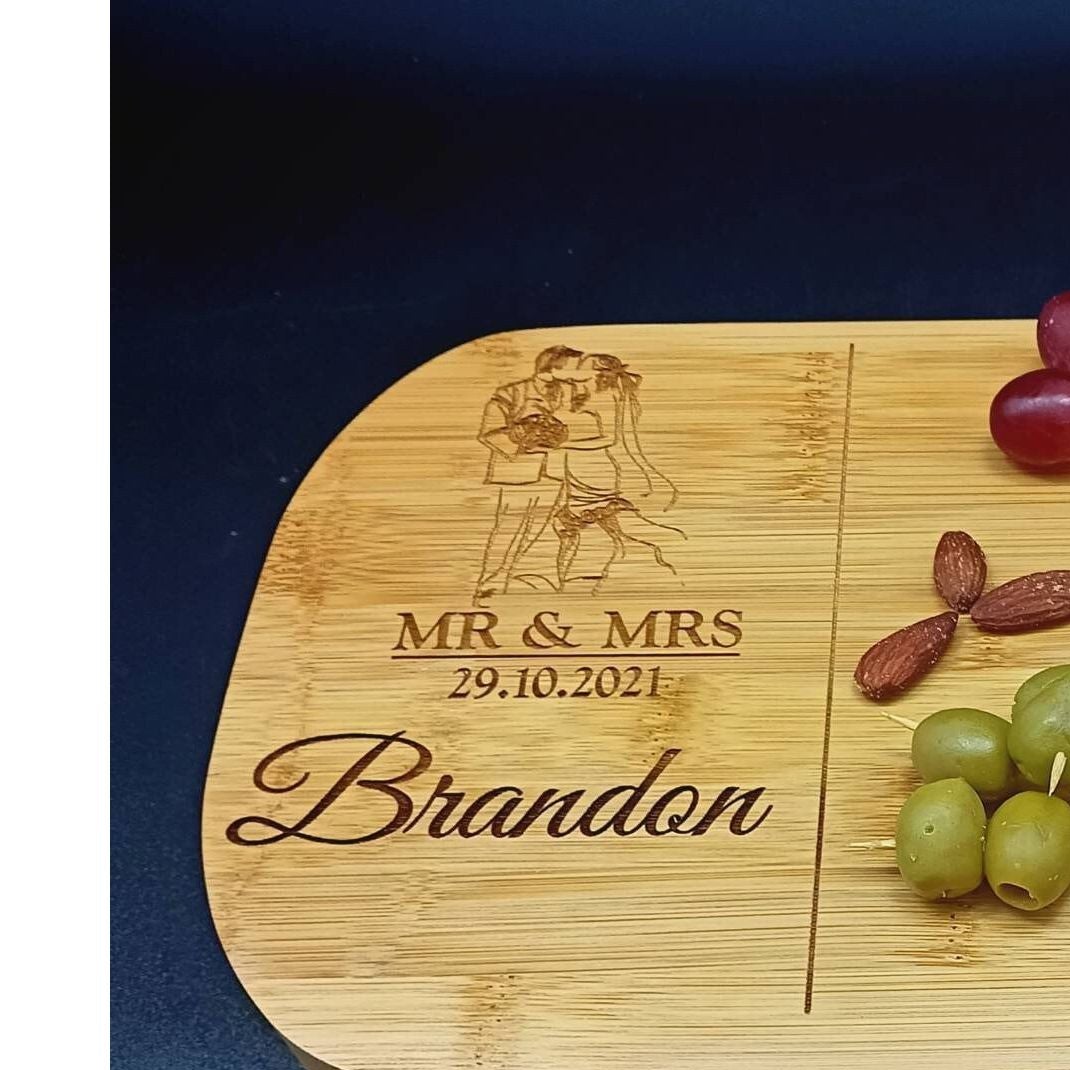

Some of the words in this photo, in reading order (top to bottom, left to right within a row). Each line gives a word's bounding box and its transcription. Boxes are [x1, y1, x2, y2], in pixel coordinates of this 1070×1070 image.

[393, 611, 499, 651] MR
[522, 611, 581, 649] &
[603, 609, 743, 650] MRS
[448, 666, 662, 699] 29.10.2021
[225, 730, 774, 847] Brandon
